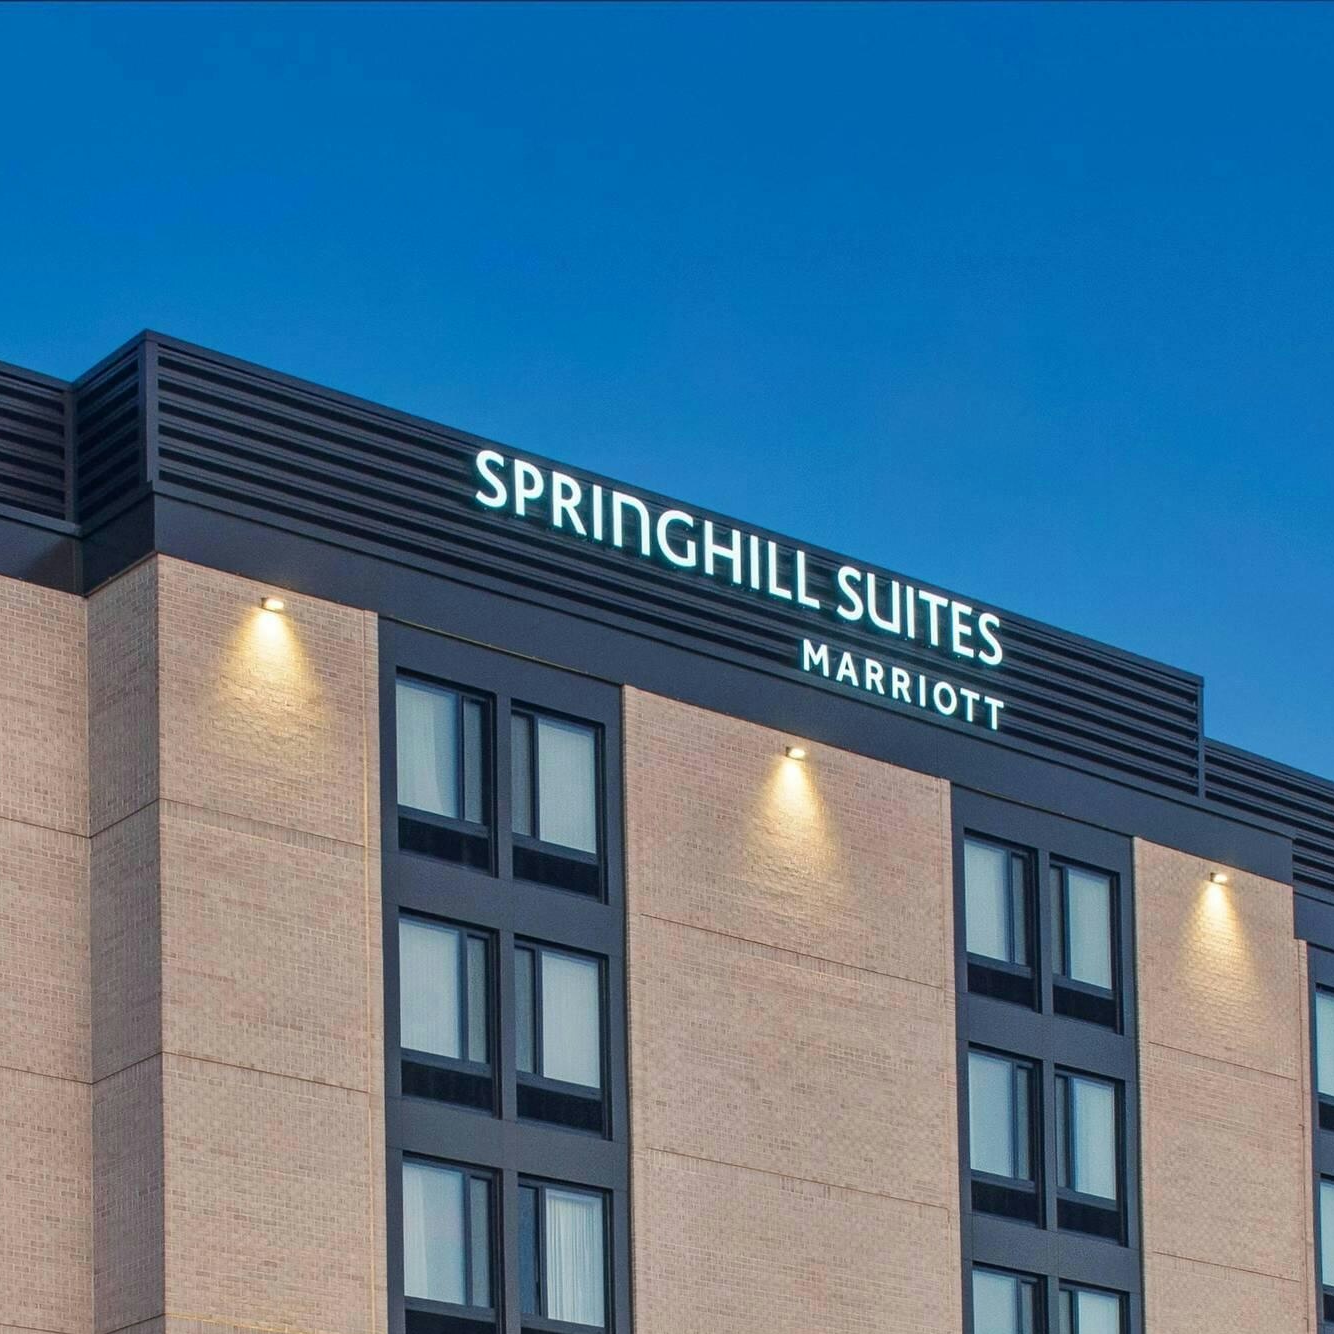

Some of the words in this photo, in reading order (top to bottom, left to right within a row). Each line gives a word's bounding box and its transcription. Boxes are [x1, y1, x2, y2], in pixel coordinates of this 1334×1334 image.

[474, 450, 820, 609] SPRINGHILL
[836, 565, 1004, 666] SUITES
[802, 638, 1005, 731] MARRIOTT
